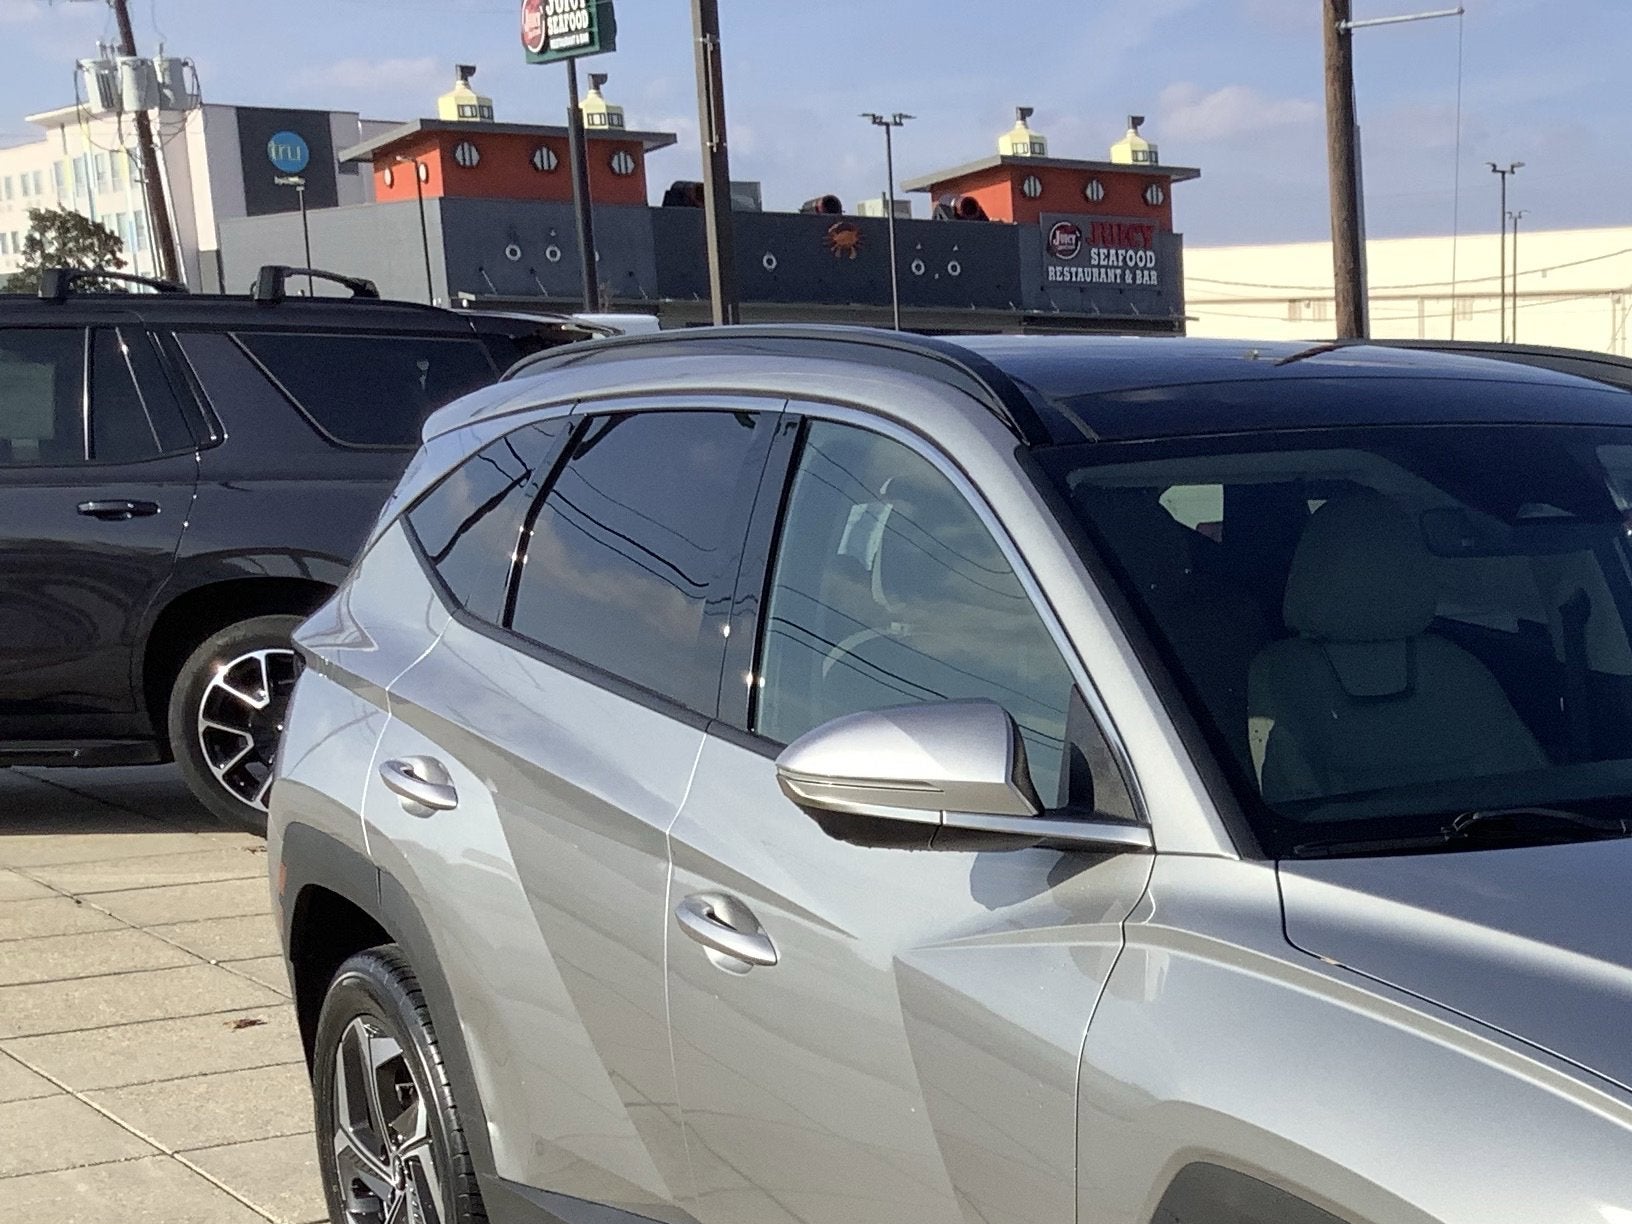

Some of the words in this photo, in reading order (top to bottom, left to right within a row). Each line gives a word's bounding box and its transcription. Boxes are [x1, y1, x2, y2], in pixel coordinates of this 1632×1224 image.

[547, 9, 589, 36] SEAFOOD
[268, 140, 300, 161] tru
[1086, 222, 1153, 249] JUICY
[1090, 248, 1155, 268] SEAFOOD
[1048, 266, 1121, 283] RESTAURANT
[1125, 269, 1133, 284] &
[1136, 270, 1158, 285] BAR
